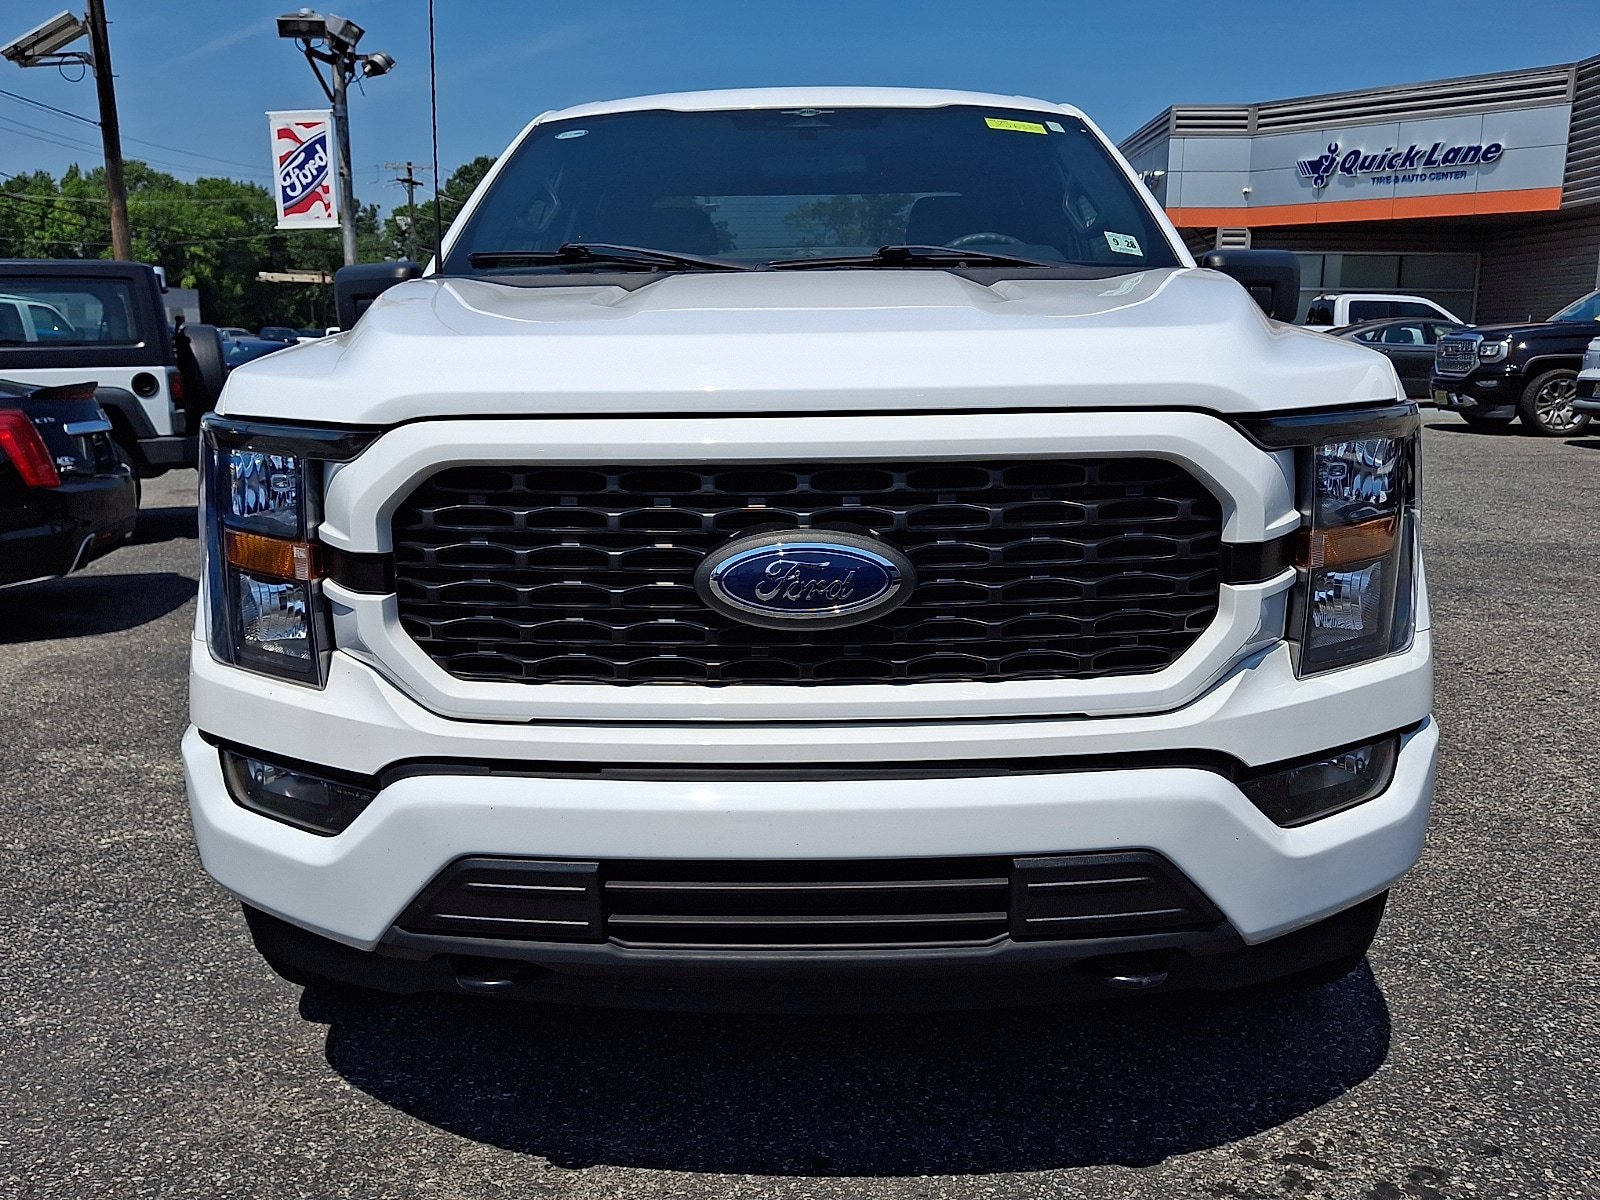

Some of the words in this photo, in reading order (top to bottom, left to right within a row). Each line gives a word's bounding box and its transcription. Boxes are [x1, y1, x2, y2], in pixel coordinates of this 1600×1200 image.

[280, 143, 327, 196] Ford
[1340, 144, 1426, 175] Quick
[1422, 142, 1502, 165] Lane
[1370, 176, 1392, 185] TIRE
[1401, 173, 1427, 183] AUTO
[1428, 170, 1467, 182] CENTER
[1112, 238, 1119, 246] 9
[1125, 239, 1137, 249] 28
[755, 560, 858, 601] Ford
